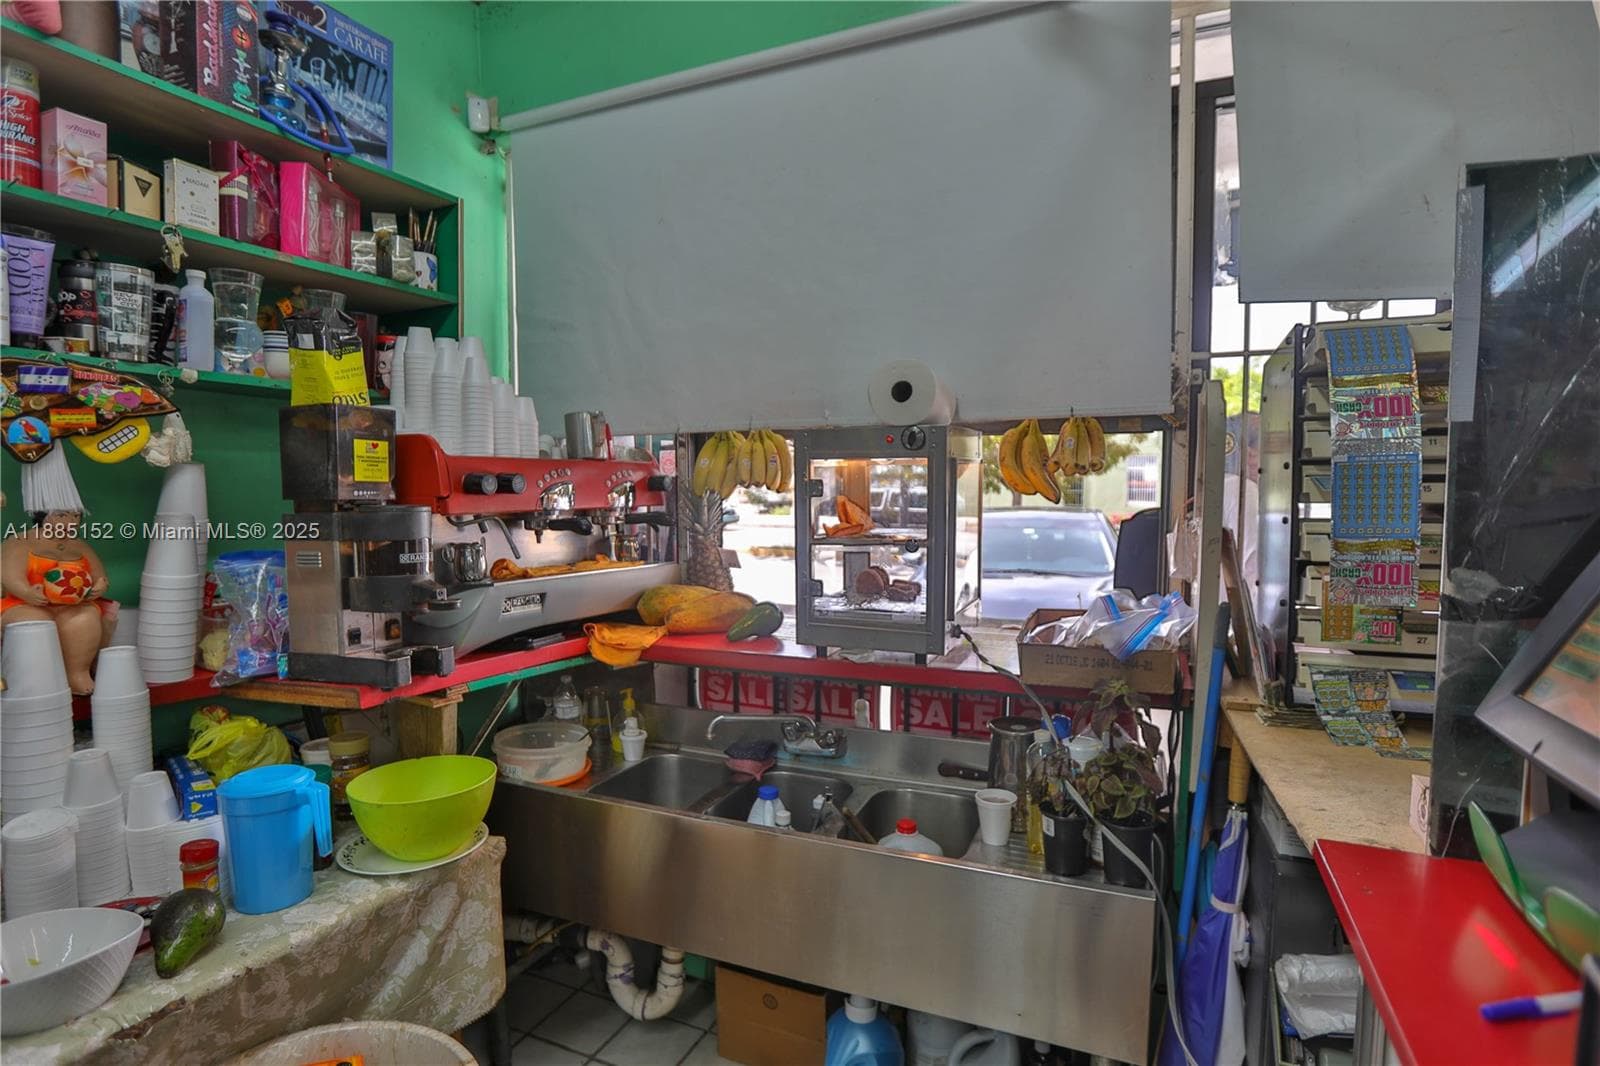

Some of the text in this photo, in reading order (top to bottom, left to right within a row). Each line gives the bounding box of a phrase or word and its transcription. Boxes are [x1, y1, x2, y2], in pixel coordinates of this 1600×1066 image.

[313, 5, 328, 34] 2
[334, 27, 388, 66] CARAFE
[7, 244, 31, 304] BODY
[1356, 562, 1413, 587] 100X
[902, 696, 996, 732] SALE
